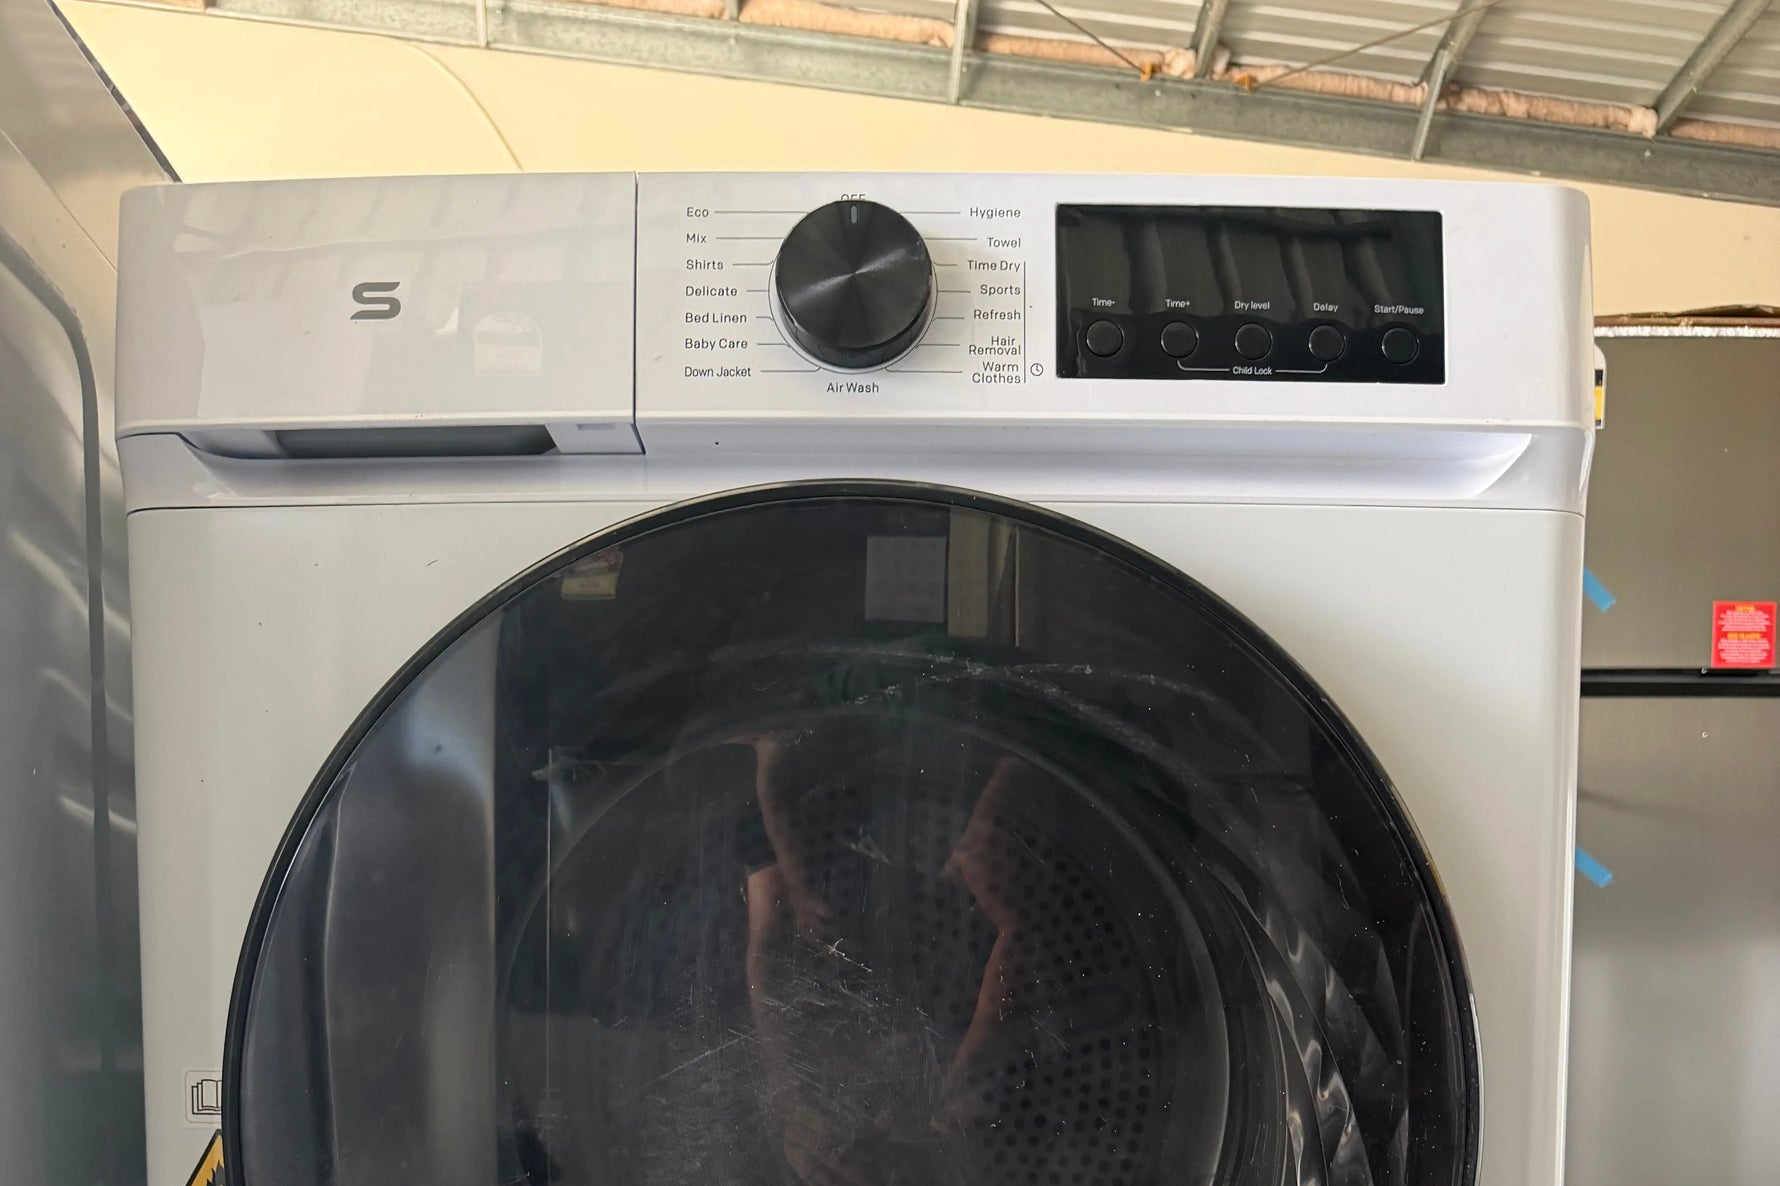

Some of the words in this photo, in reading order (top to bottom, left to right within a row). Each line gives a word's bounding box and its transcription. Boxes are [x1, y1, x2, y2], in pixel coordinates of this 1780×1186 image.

[686, 206, 709, 218] Eco
[970, 207, 1021, 219] Hygiene
[686, 233, 707, 243] Mix
[987, 237, 1021, 248] Towel
[686, 259, 724, 270] Shirts
[968, 260, 997, 270] Time
[1000, 260, 1021, 272] Dry
[685, 286, 738, 296] Delicate
[980, 284, 1021, 296] Sports
[1165, 299, 1191, 308] Time+
[1234, 301, 1249, 311] Dry
[1250, 301, 1270, 310] level
[1313, 303, 1338, 313] Delay
[1374, 304, 1424, 314] Start/Pause
[685, 312, 709, 323] Bed
[713, 313, 747, 323] Linen
[973, 309, 1021, 320] Refresh
[685, 338, 716, 351] Baby
[719, 338, 748, 349] Care
[991, 336, 1016, 346] Hair
[969, 345, 1021, 355] Removal
[685, 366, 714, 377] Down
[716, 366, 751, 377] Jacket
[982, 361, 1019, 372] Warm
[1232, 366, 1253, 375] Child
[1254, 366, 1273, 375] Lock
[972, 372, 1021, 384] Clothes
[826, 382, 844, 393] Air
[846, 382, 880, 393] Wash
